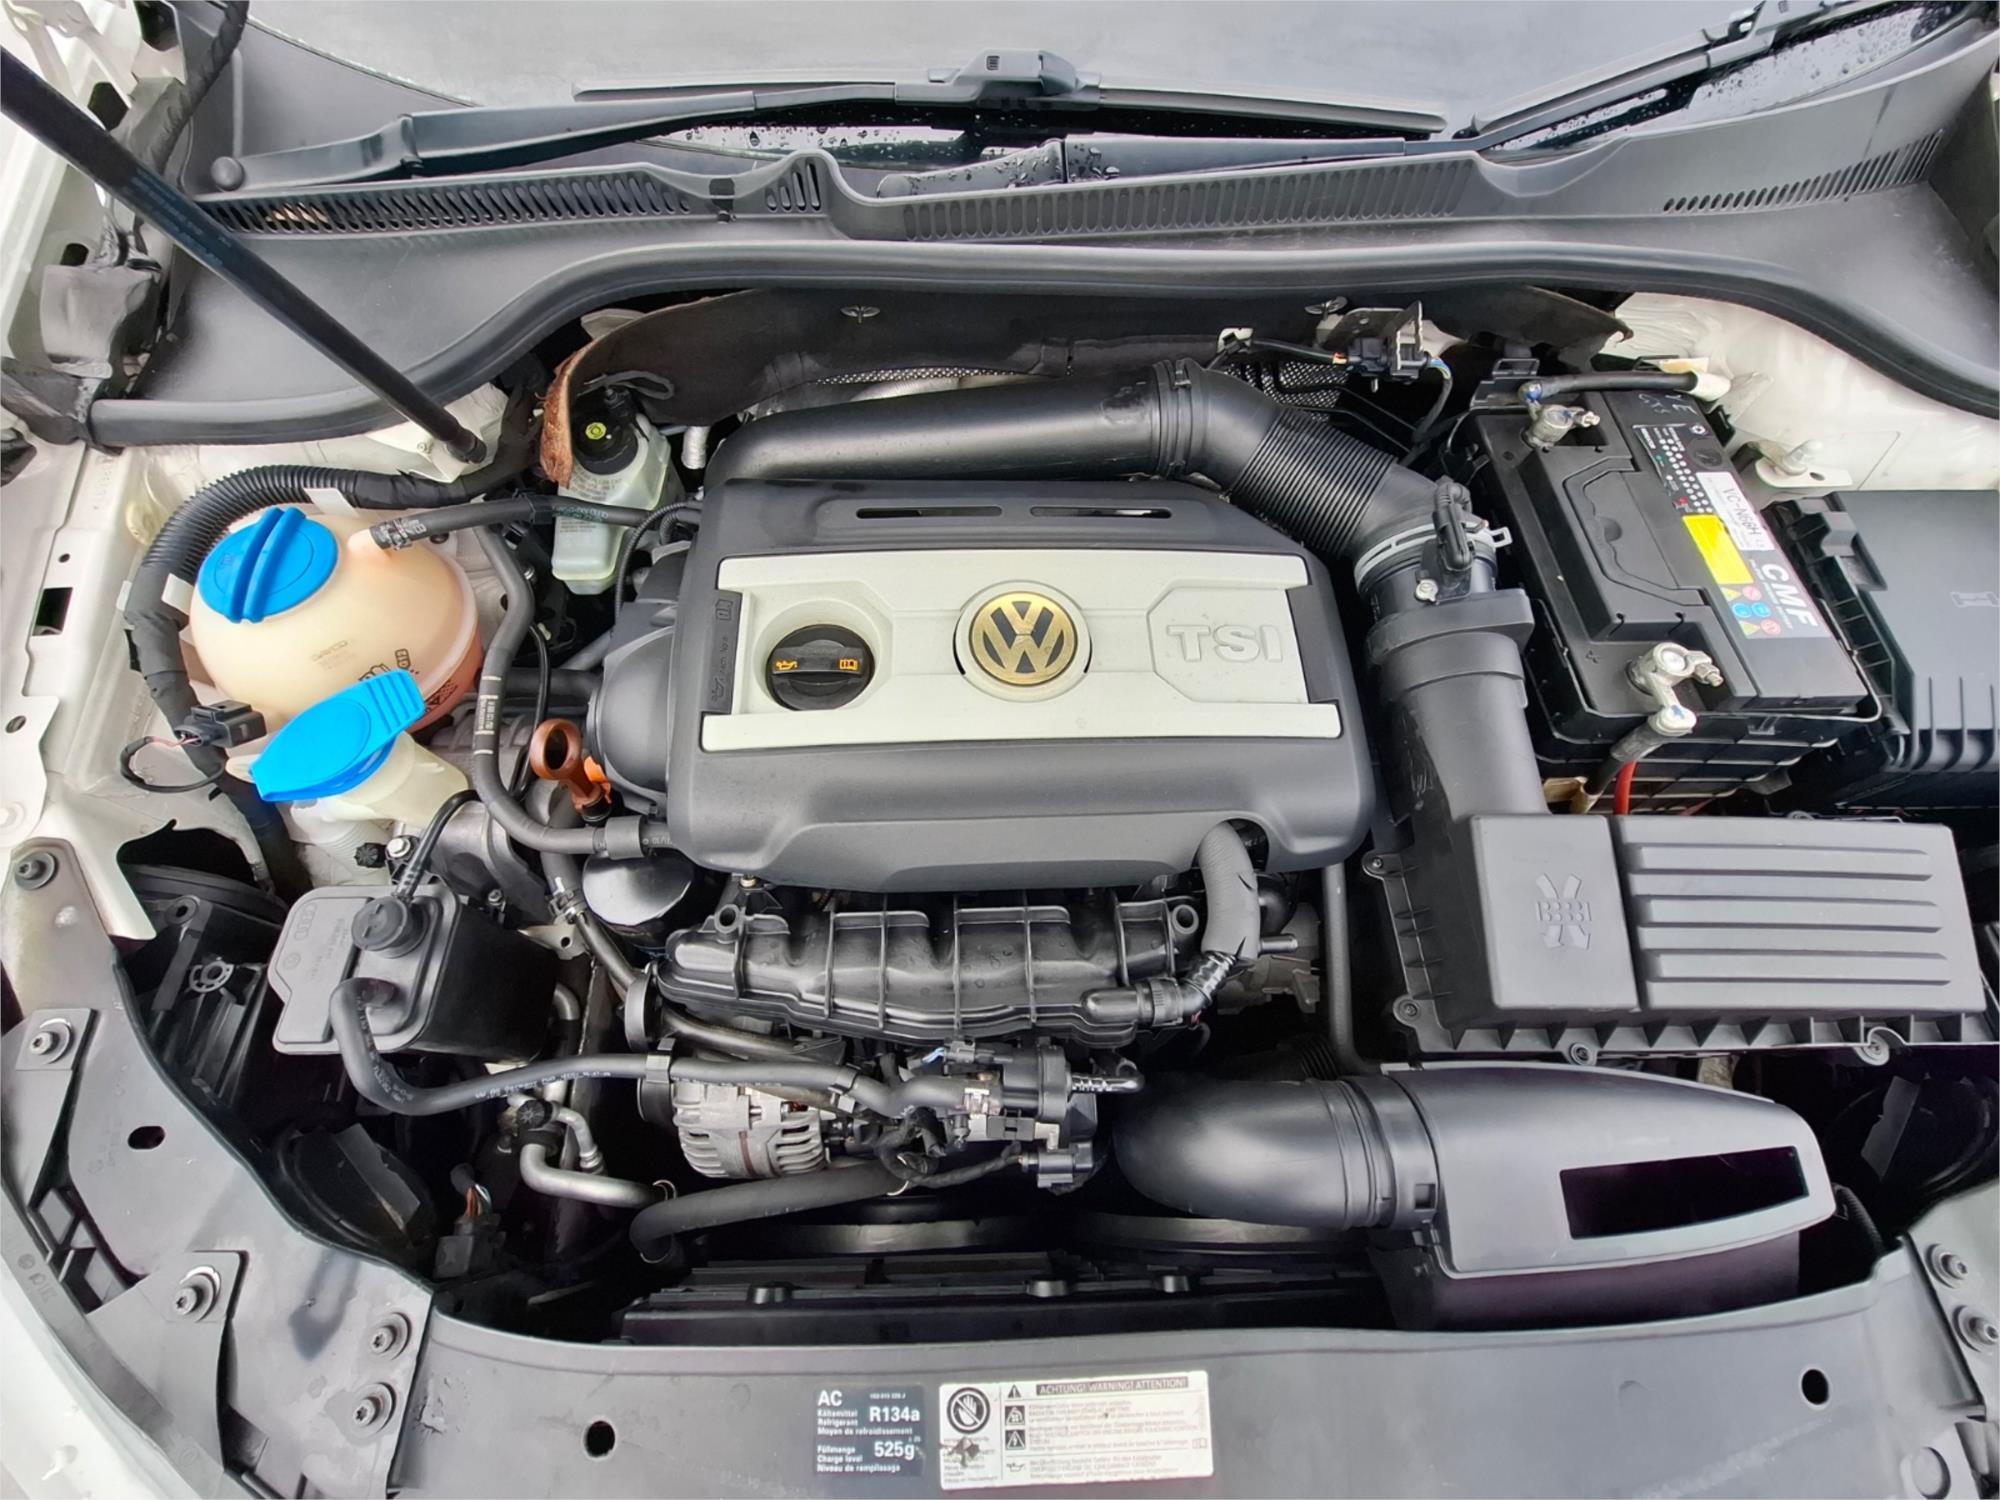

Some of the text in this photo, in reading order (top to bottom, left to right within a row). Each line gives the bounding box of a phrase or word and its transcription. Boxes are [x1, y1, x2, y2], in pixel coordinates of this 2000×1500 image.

[1761, 563, 1818, 627] CMF
[969, 591, 1078, 687] VW
[1166, 623, 1284, 663] TSI
[1039, 1378, 1187, 1395] ACHTUNG! WARNING! ATTENTION!
[817, 1390, 843, 1406] AC
[869, 1405, 921, 1422] R134a
[874, 1440, 915, 1461] 525g
